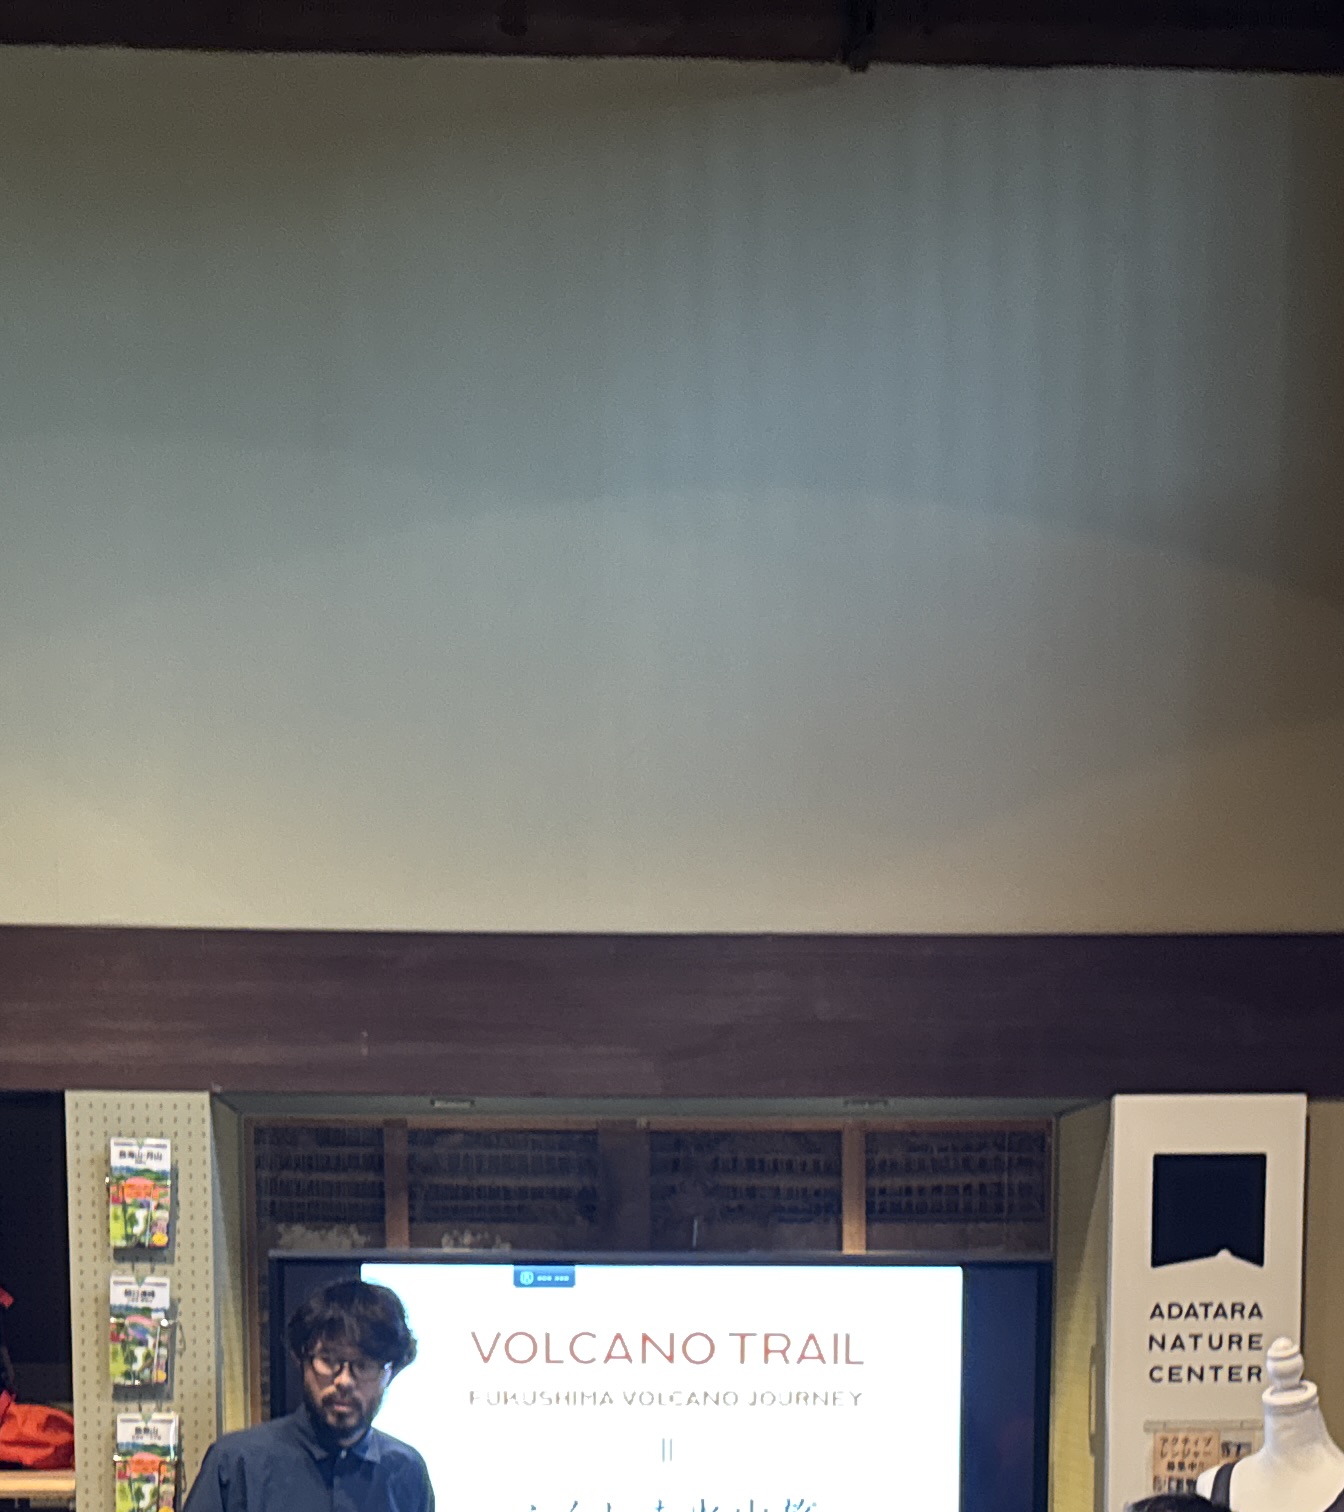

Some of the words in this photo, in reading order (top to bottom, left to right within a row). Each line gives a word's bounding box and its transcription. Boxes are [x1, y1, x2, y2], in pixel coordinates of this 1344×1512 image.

[1149, 1302, 1264, 1321] ADATARA
[470, 1331, 715, 1365] VOLCANO
[728, 1332, 864, 1365] TRAIL
[1148, 1333, 1264, 1351] NATURE
[1148, 1365, 1263, 1383] CENTER
[469, 1390, 614, 1407] FUKUSHIMA
[622, 1390, 739, 1407] VOLCANO
[747, 1390, 863, 1407] JOURNEY
